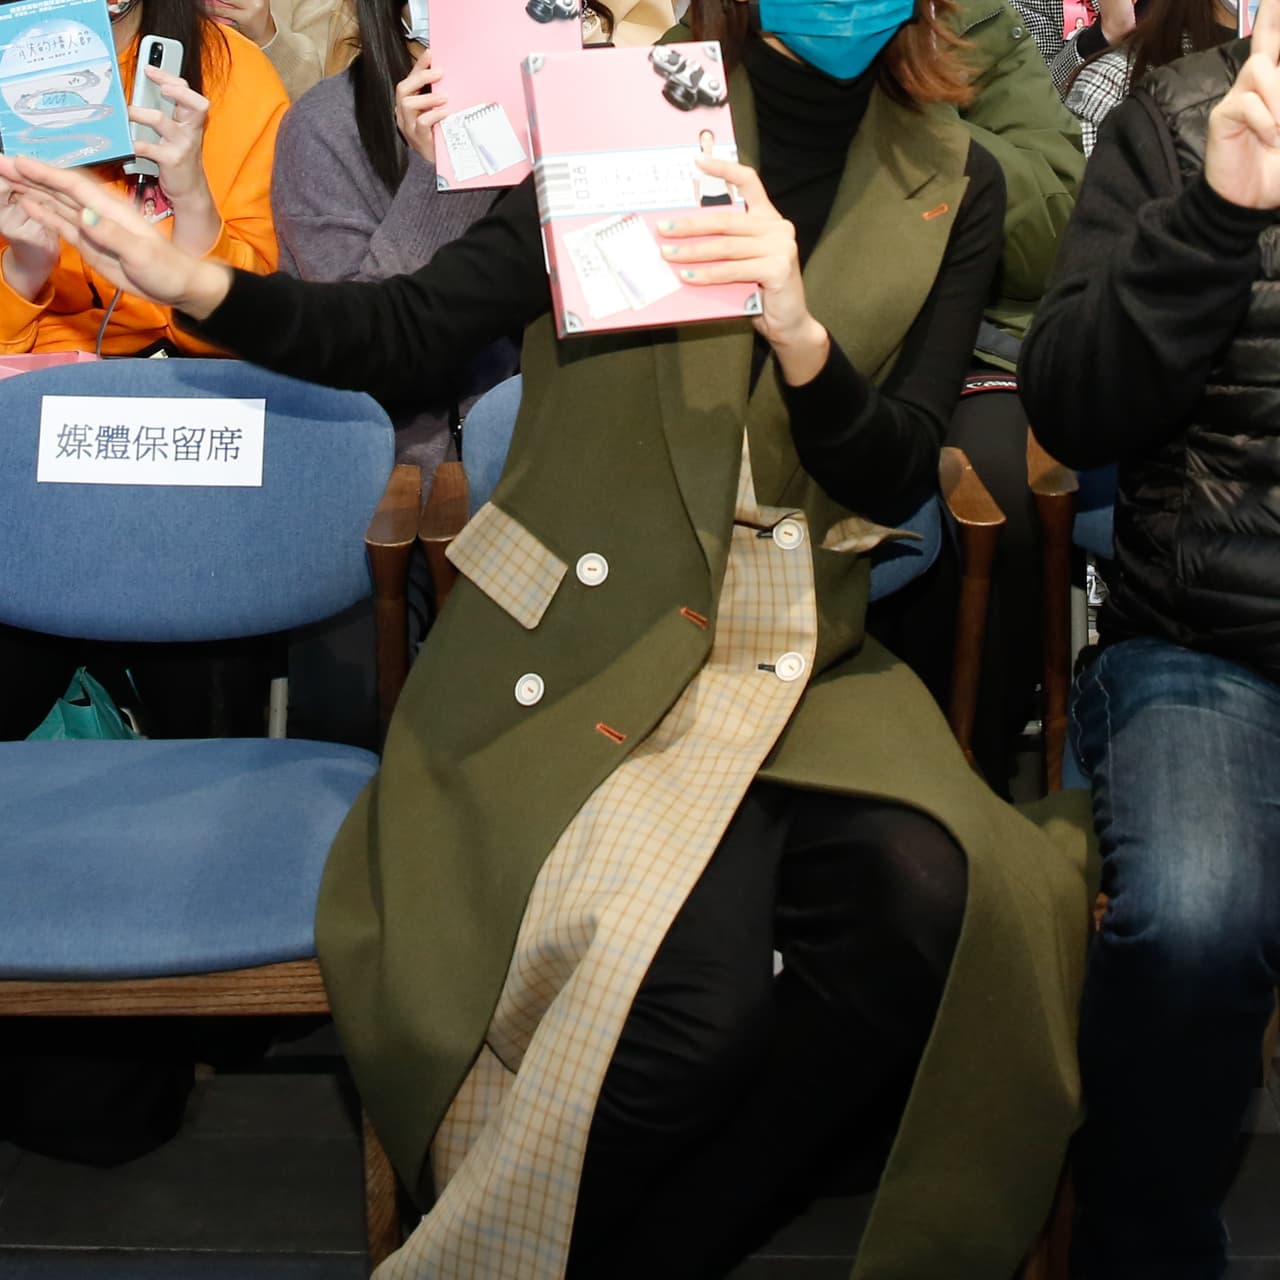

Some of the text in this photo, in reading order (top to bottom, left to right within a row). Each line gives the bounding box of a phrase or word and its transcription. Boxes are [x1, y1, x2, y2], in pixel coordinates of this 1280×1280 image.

[54, 423, 243, 463] 媒體保留席
